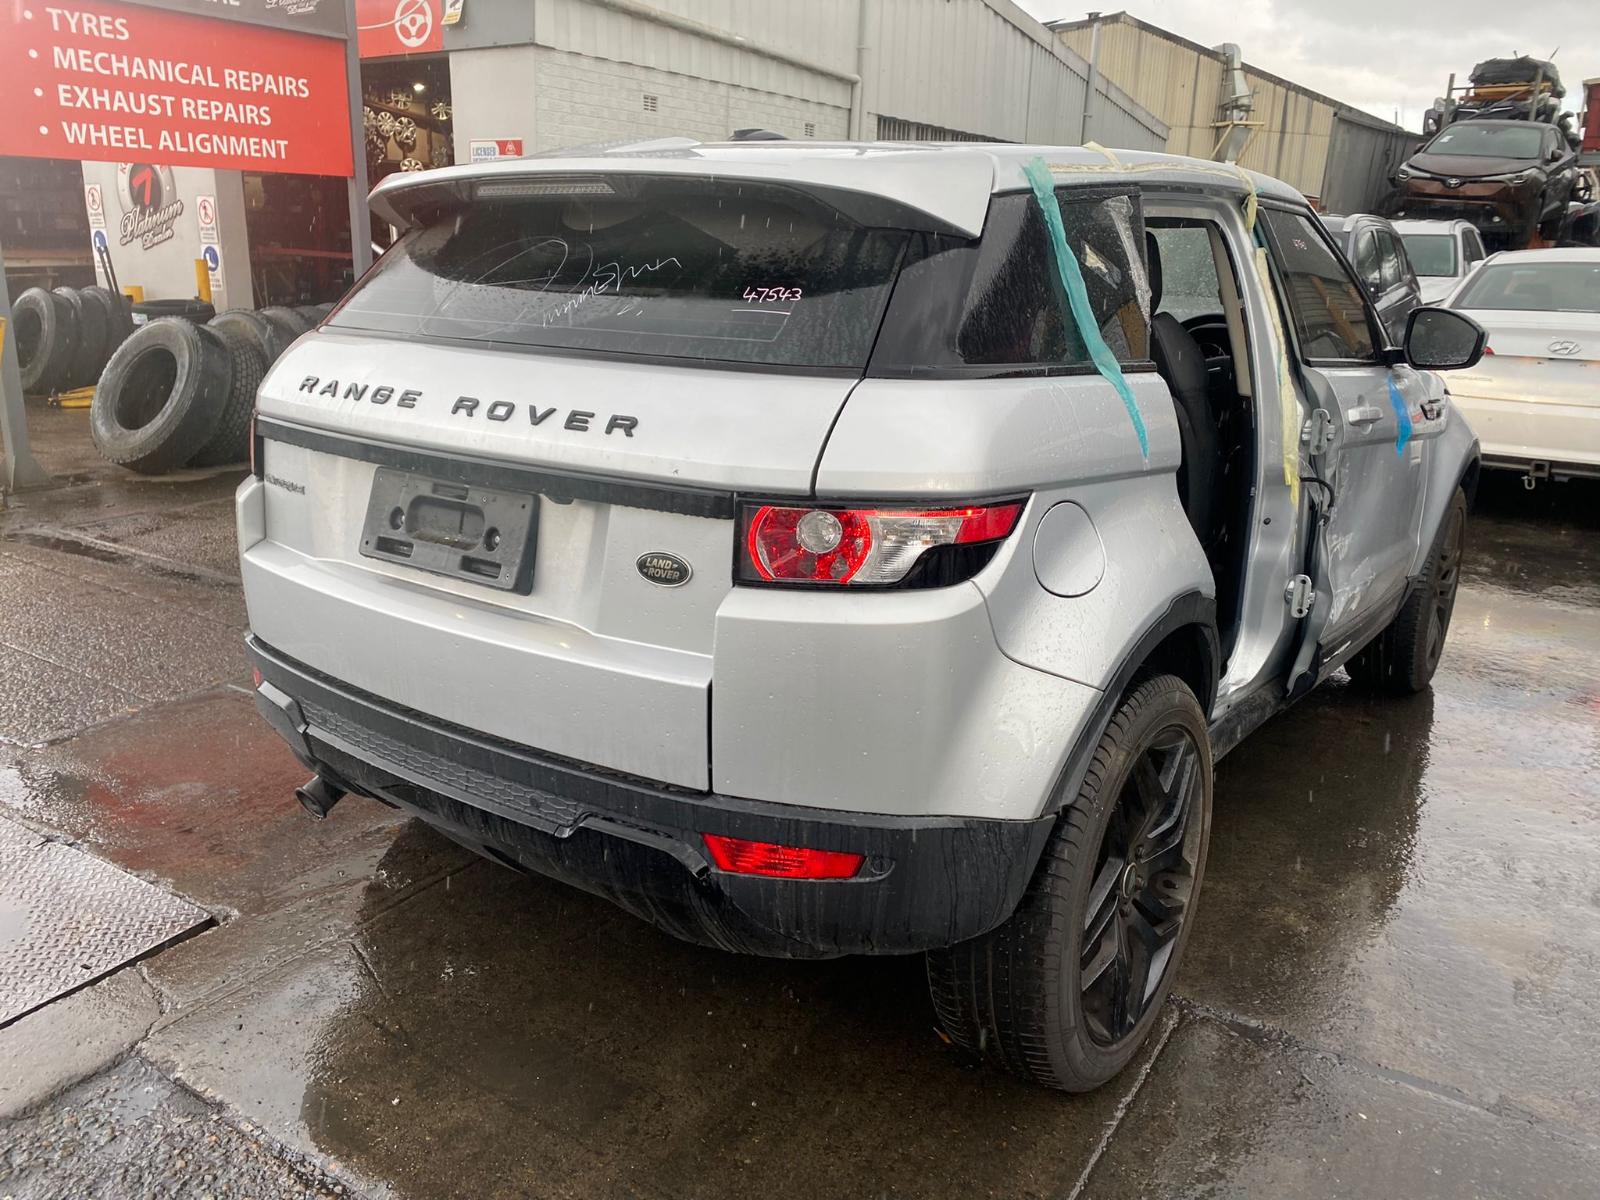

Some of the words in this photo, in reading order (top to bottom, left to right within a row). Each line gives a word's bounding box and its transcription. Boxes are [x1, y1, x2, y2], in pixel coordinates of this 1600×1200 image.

[46, 8, 129, 41] TYRES
[53, 46, 219, 88] MECHANICAL
[223, 69, 310, 98] REPAIRS
[58, 84, 175, 117] EXHAUST
[181, 98, 272, 126] REPAIRS
[62, 121, 152, 149] WHEEL
[158, 132, 288, 160] ALIGNMENT
[120, 199, 184, 246] Platinum
[742, 287, 802, 303] 47543
[298, 375, 423, 409] RANGE
[451, 395, 640, 438] ROVER
[645, 557, 672, 570] LAND
[647, 567, 680, 580] ROVER
